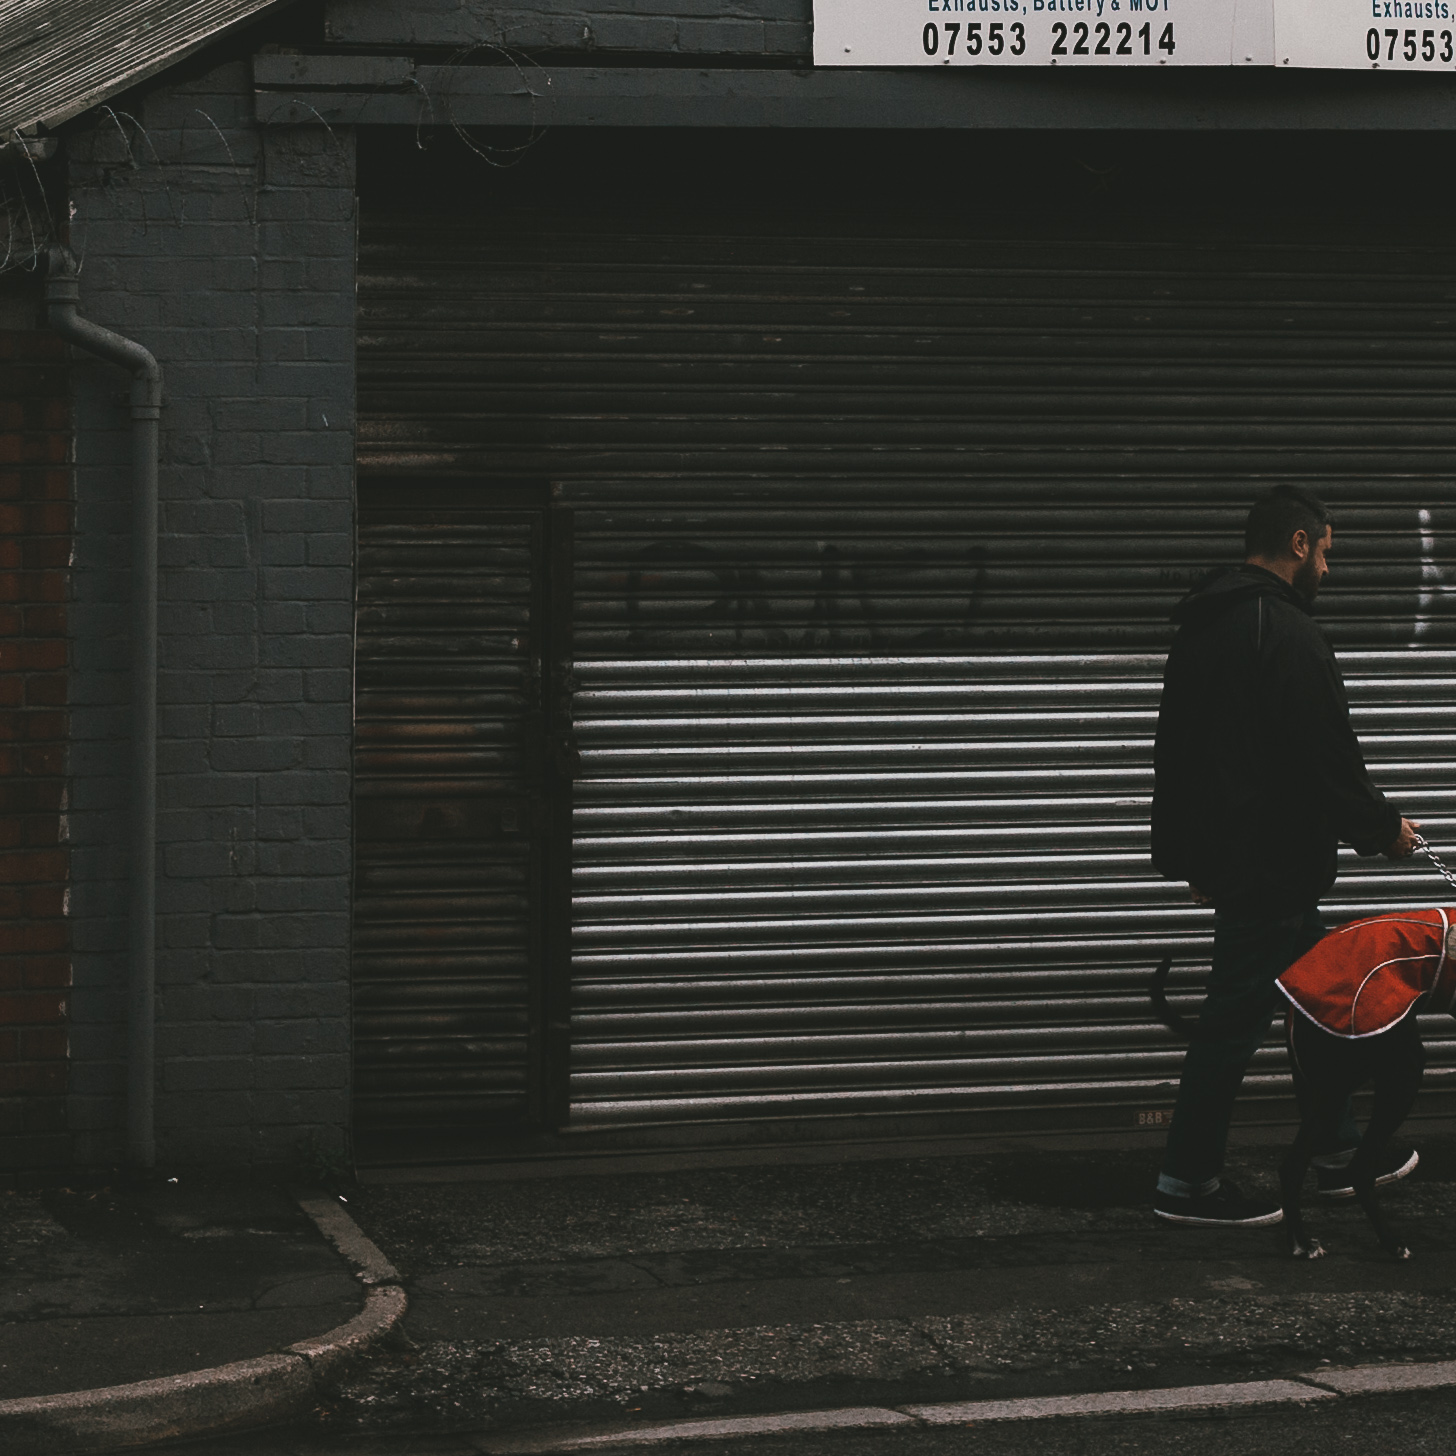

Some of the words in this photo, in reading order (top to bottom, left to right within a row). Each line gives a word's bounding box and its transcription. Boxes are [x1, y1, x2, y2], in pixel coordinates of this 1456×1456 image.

[923, 22, 1026, 55] 07553
[1051, 22, 1175, 55] 222214
[1367, 28, 1453, 63] 07553
